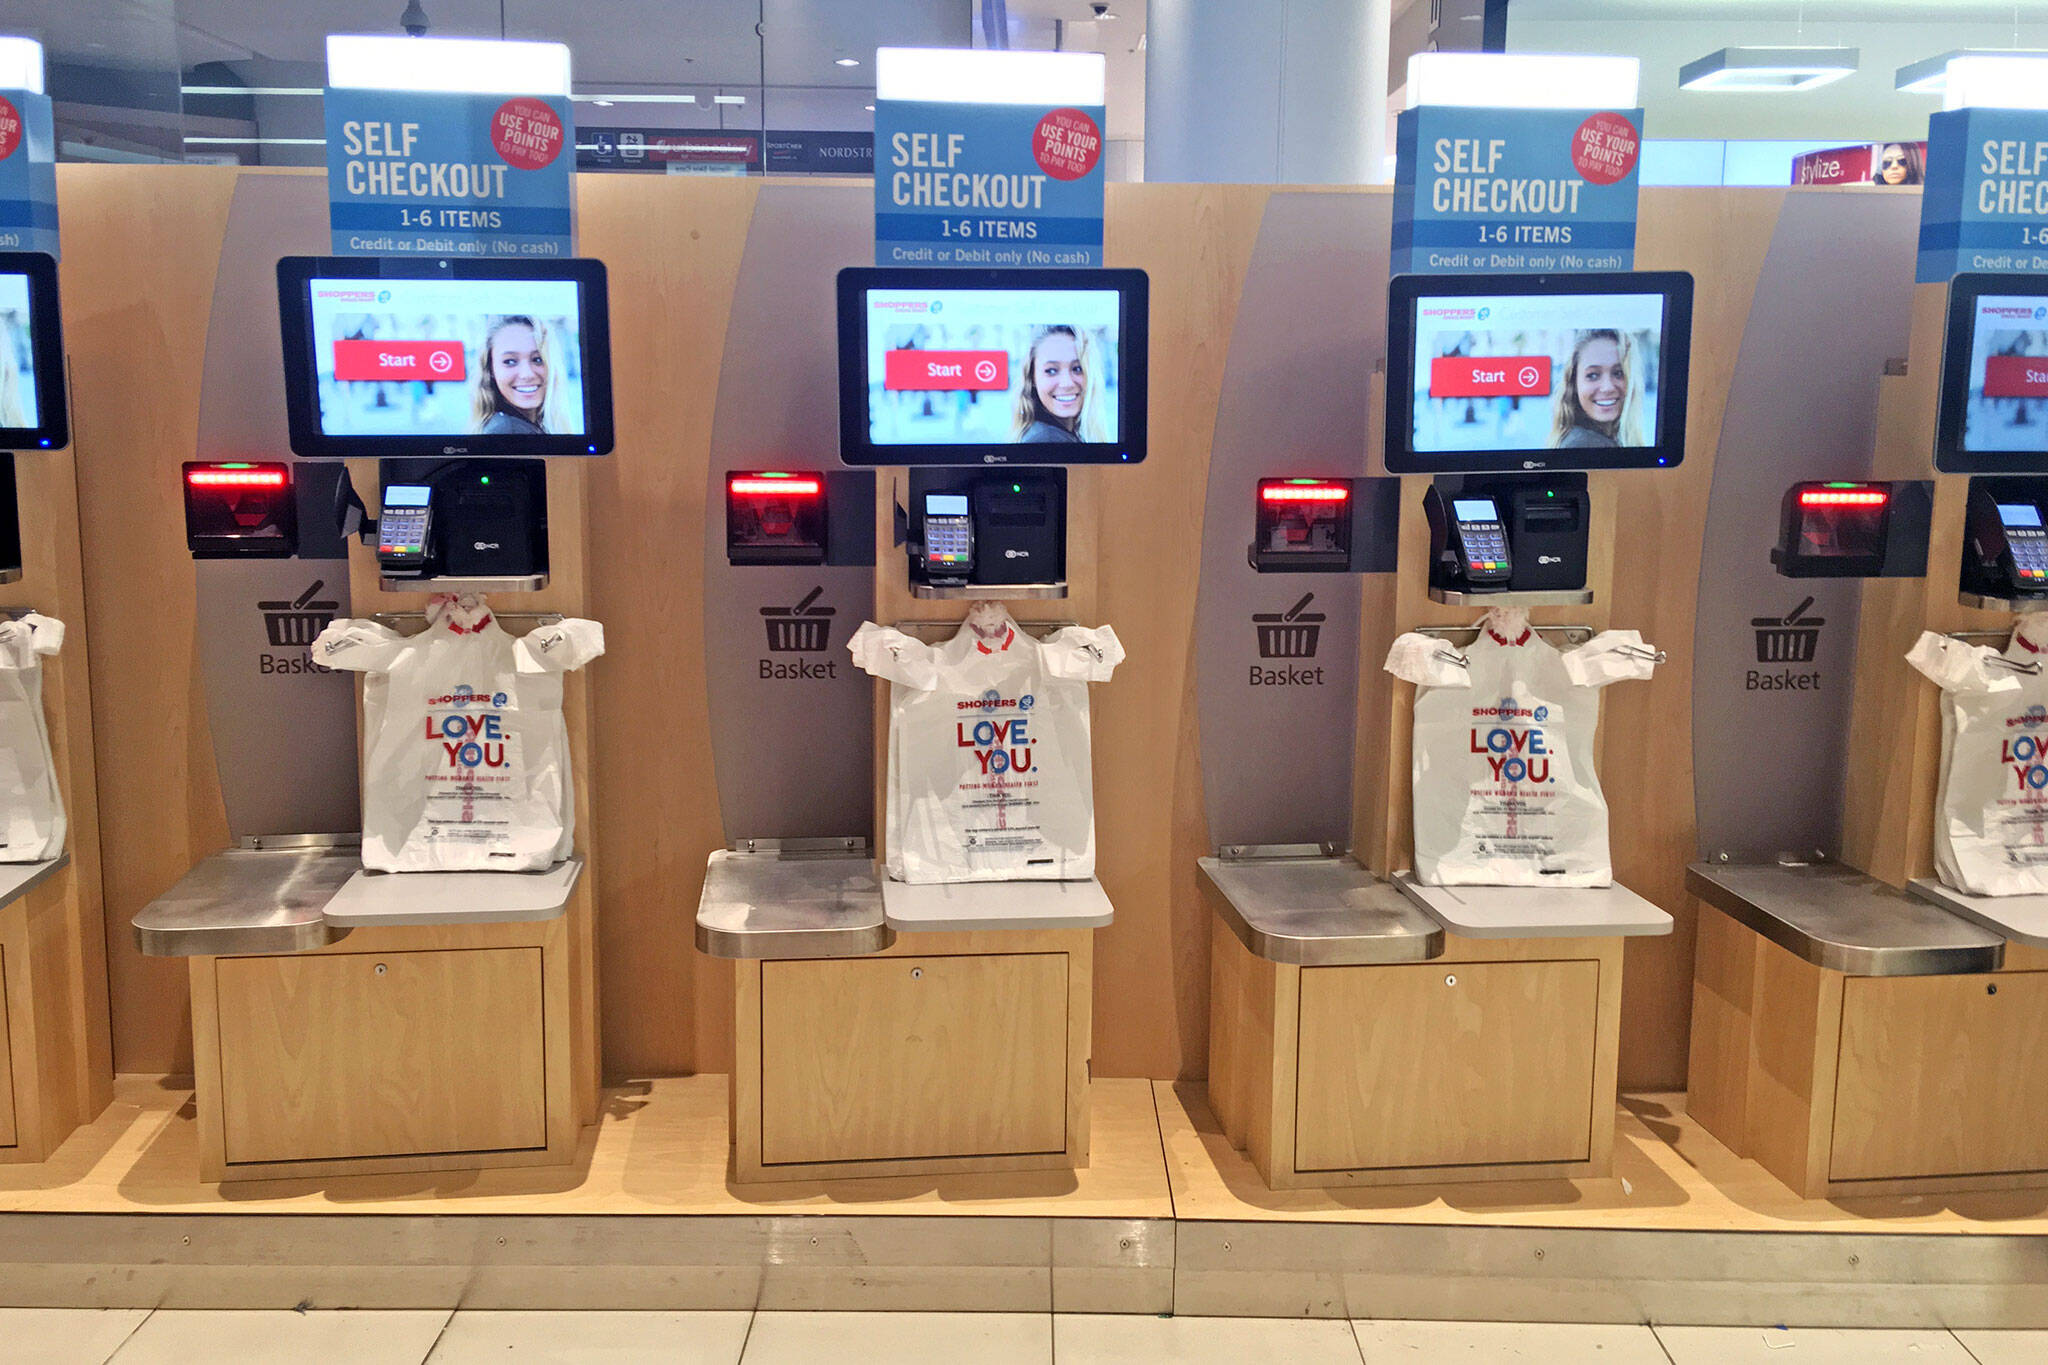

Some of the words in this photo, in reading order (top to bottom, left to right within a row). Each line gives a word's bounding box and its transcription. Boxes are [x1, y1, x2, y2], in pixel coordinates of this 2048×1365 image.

[499, 112, 524, 130] USE
[527, 119, 559, 140] YOUR
[1041, 123, 1064, 141] USE
[1067, 129, 1097, 152] YOUR
[344, 121, 419, 157] SELF
[504, 128, 549, 152] POINTS
[892, 132, 964, 168] SELF
[1045, 139, 1087, 162] POINTS
[1581, 127, 1603, 145] USE
[1606, 134, 1635, 155] YOUR
[1433, 138, 1505, 174] SELF
[1584, 143, 1624, 166] POINTS
[1981, 140, 2048, 175] SELF
[346, 161, 507, 198] CHECKOUT
[892, 172, 1046, 209] CHECKOUT
[1433, 177, 1584, 214] CHECKOUT
[401, 209, 432, 226] 1-6
[440, 211, 501, 228] ITEMS
[942, 220, 971, 237] 1-6
[979, 221, 1037, 239] ITEMS
[1479, 225, 1507, 243] 1-6
[1515, 226, 1572, 243] ITEMS
[350, 237, 392, 250] Credit
[398, 240, 412, 250] or
[417, 238, 453, 251] Debit
[458, 240, 487, 255] only
[491, 240, 516, 254] (No
[523, 241, 558, 255] cash)
[893, 247, 932, 260] Credit
[937, 251, 951, 261] or
[955, 248, 991, 262] Debit
[995, 250, 1022, 265] only
[1027, 250, 1050, 264] (No
[1055, 251, 1090, 265] cash)
[1430, 254, 1468, 267] Credit
[1473, 257, 1485, 267] or
[1490, 254, 1525, 268] Debit
[1529, 255, 1556, 271] only
[1560, 255, 1583, 269] (No
[1587, 255, 1622, 270] cash)
[1973, 255, 2012, 269] Credit
[2015, 259, 2028, 269] or
[378, 353, 416, 367] Start
[927, 363, 962, 377] Start
[1472, 369, 1505, 383] Start
[260, 654, 343, 674] Bask
[760, 657, 836, 679] Basket
[1249, 664, 1324, 685] Basket
[1746, 669, 1820, 690] Basket
[957, 699, 1017, 709] SHOPPERS
[1472, 707, 1532, 717] SHOPPERS
[426, 714, 510, 739] LOVE.
[957, 719, 1037, 747] LOVE.
[1471, 728, 1553, 755] LOVE.
[443, 742, 510, 767] YOU.
[974, 748, 1037, 775] YOU.
[1487, 756, 1555, 783] YOU.
